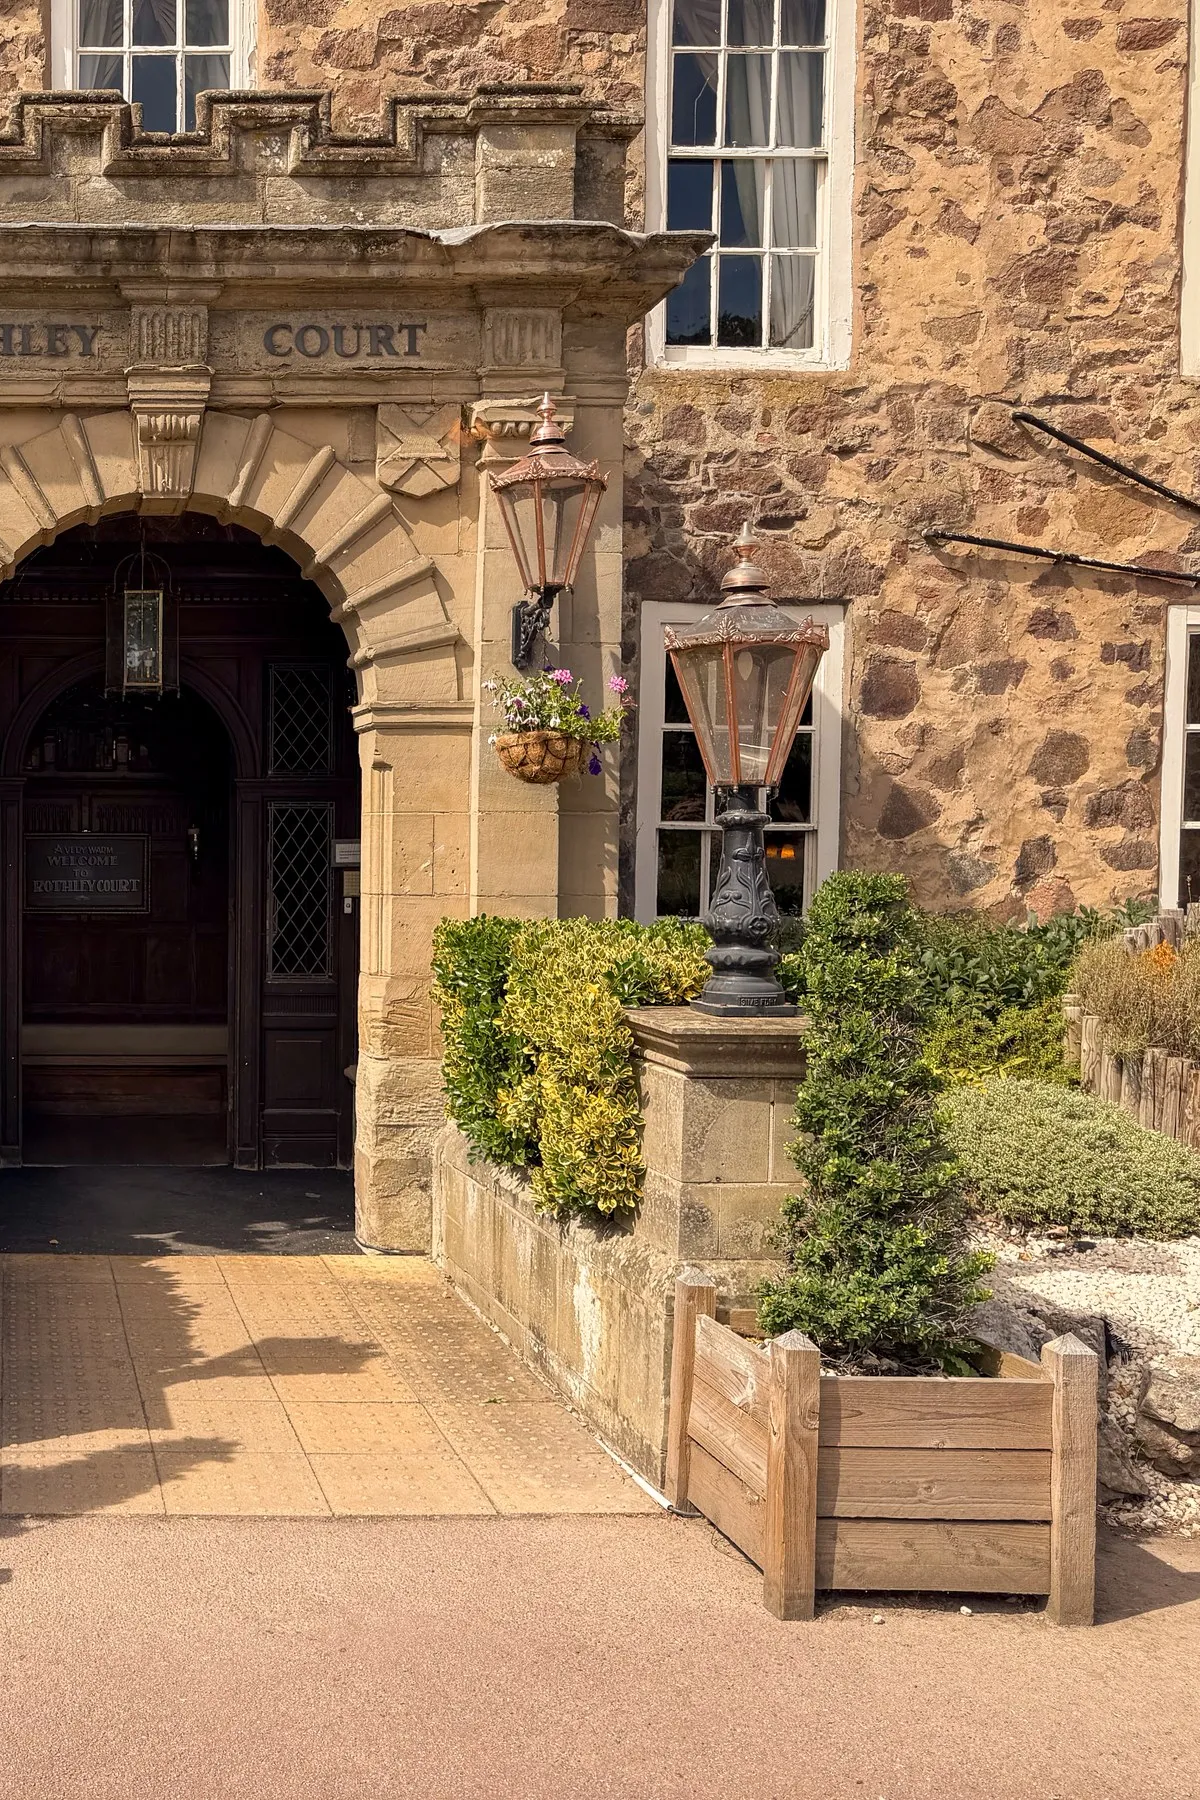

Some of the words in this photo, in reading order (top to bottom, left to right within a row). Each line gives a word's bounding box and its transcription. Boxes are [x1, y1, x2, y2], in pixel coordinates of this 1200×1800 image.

[264, 323, 427, 357] COURT
[47, 855, 119, 866] WELCOME
[73, 869, 89, 877] TO
[33, 880, 95, 892] ROTHLEY
[96, 880, 140, 892] COURT
